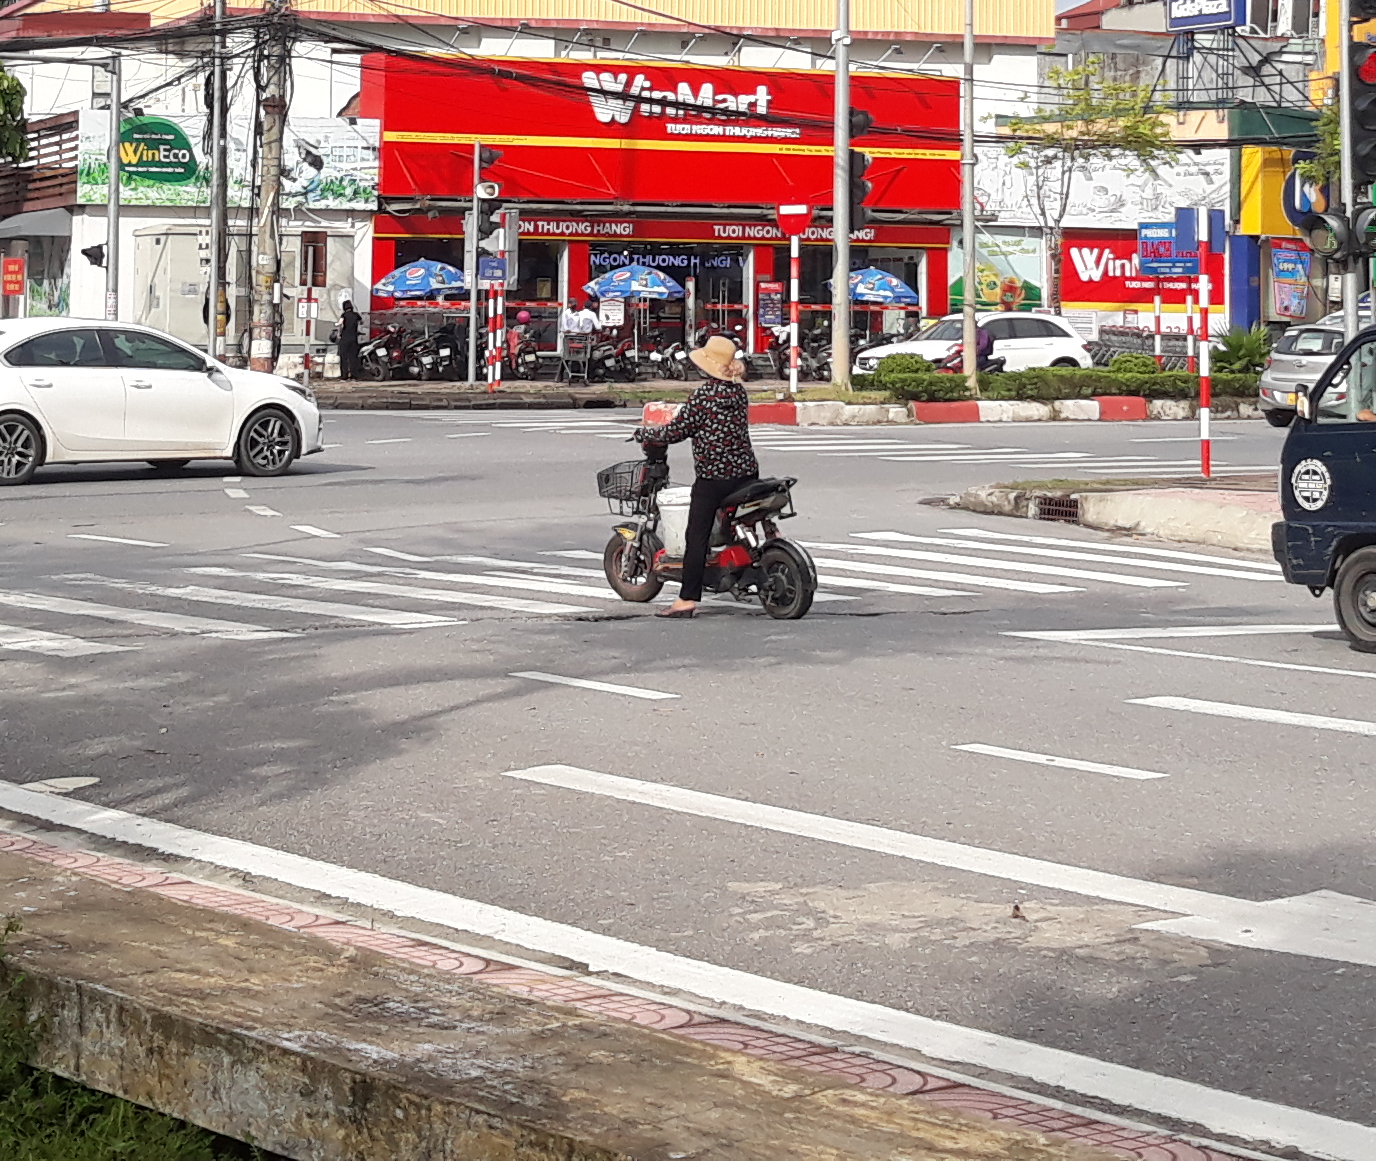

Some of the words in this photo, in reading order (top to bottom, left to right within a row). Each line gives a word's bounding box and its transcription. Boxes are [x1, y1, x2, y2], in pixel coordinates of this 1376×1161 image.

[581, 71, 772, 124] WinMart
[119, 142, 190, 165] WinEco
[745, 226, 782, 239] NGON
[590, 253, 629, 266] NGON
